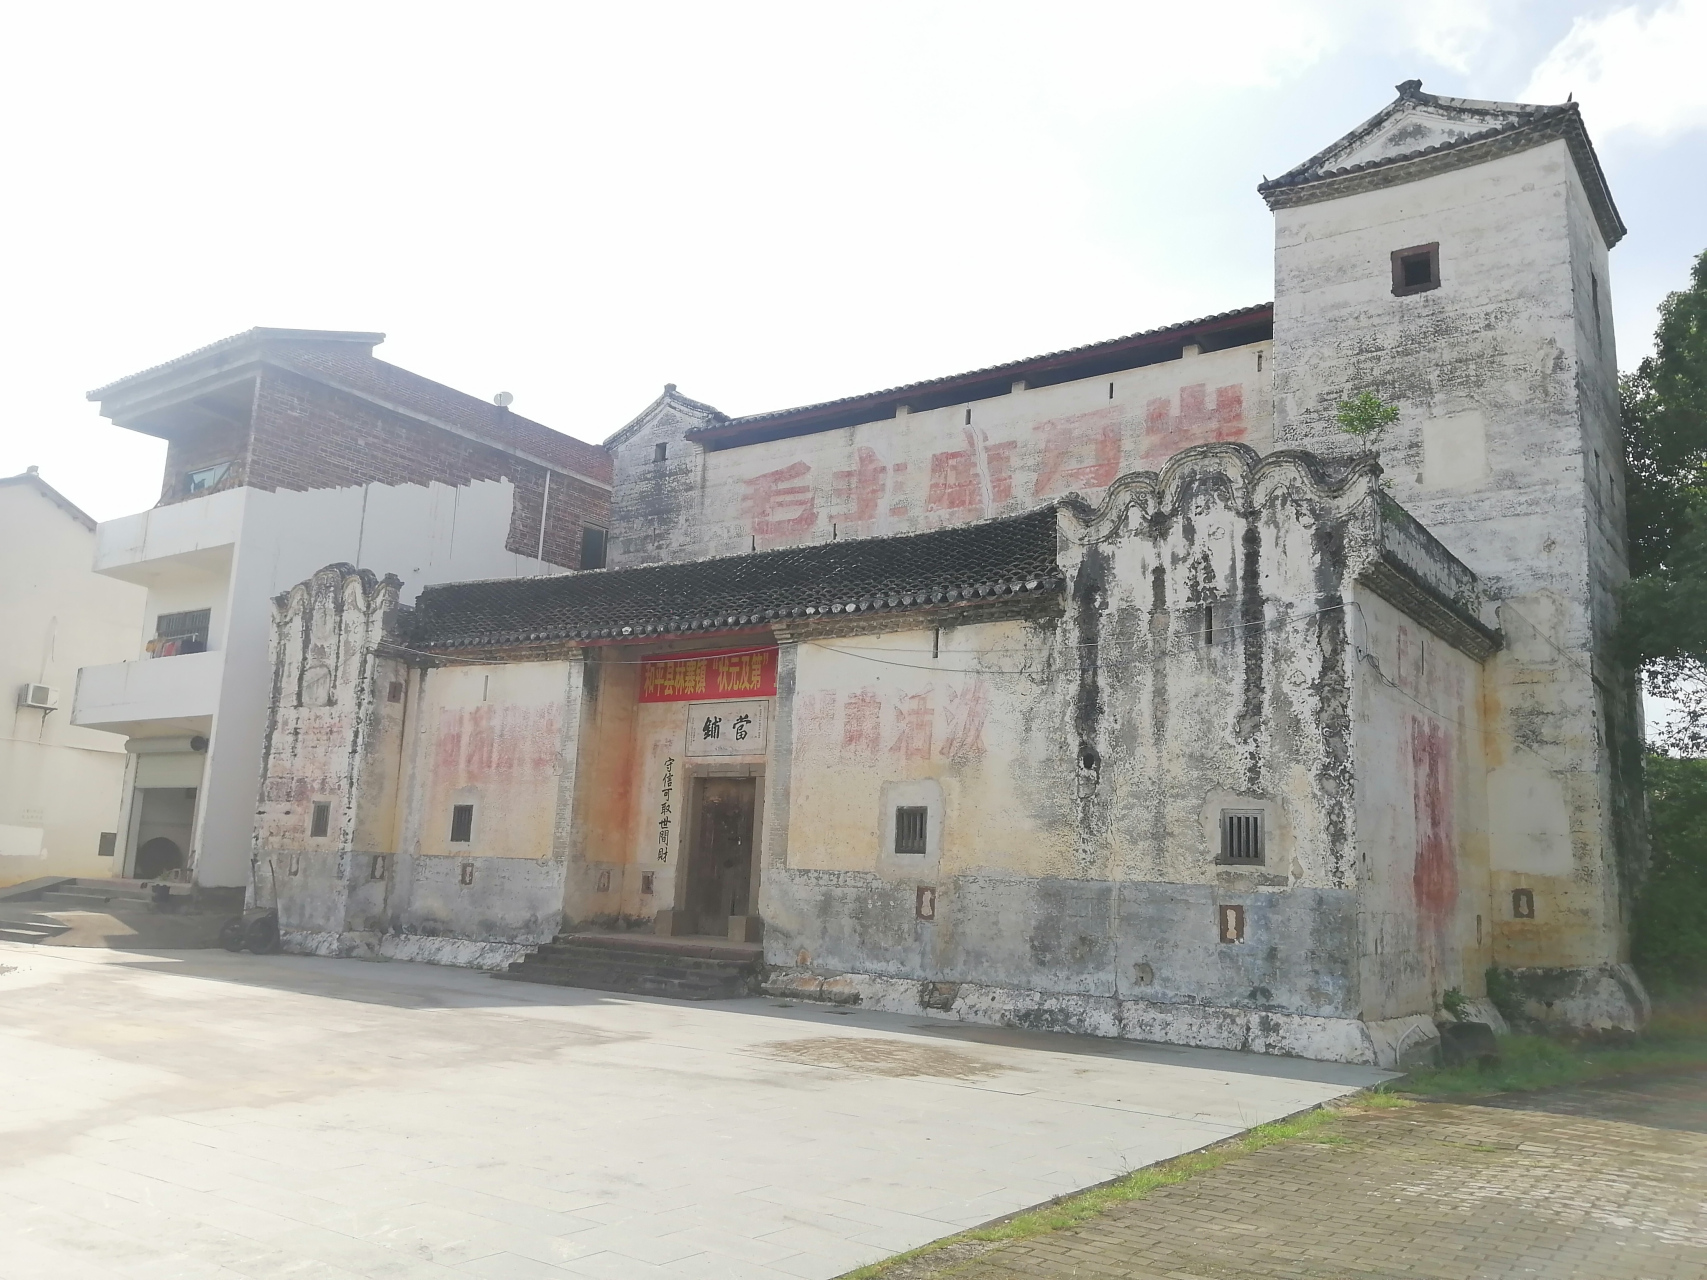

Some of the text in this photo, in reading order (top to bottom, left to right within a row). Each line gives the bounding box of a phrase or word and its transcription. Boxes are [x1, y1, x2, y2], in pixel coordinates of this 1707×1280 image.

[644, 652, 777, 697] 和平县林寨镇“状元及第”
[658, 757, 675, 863] 守信可取世間財
